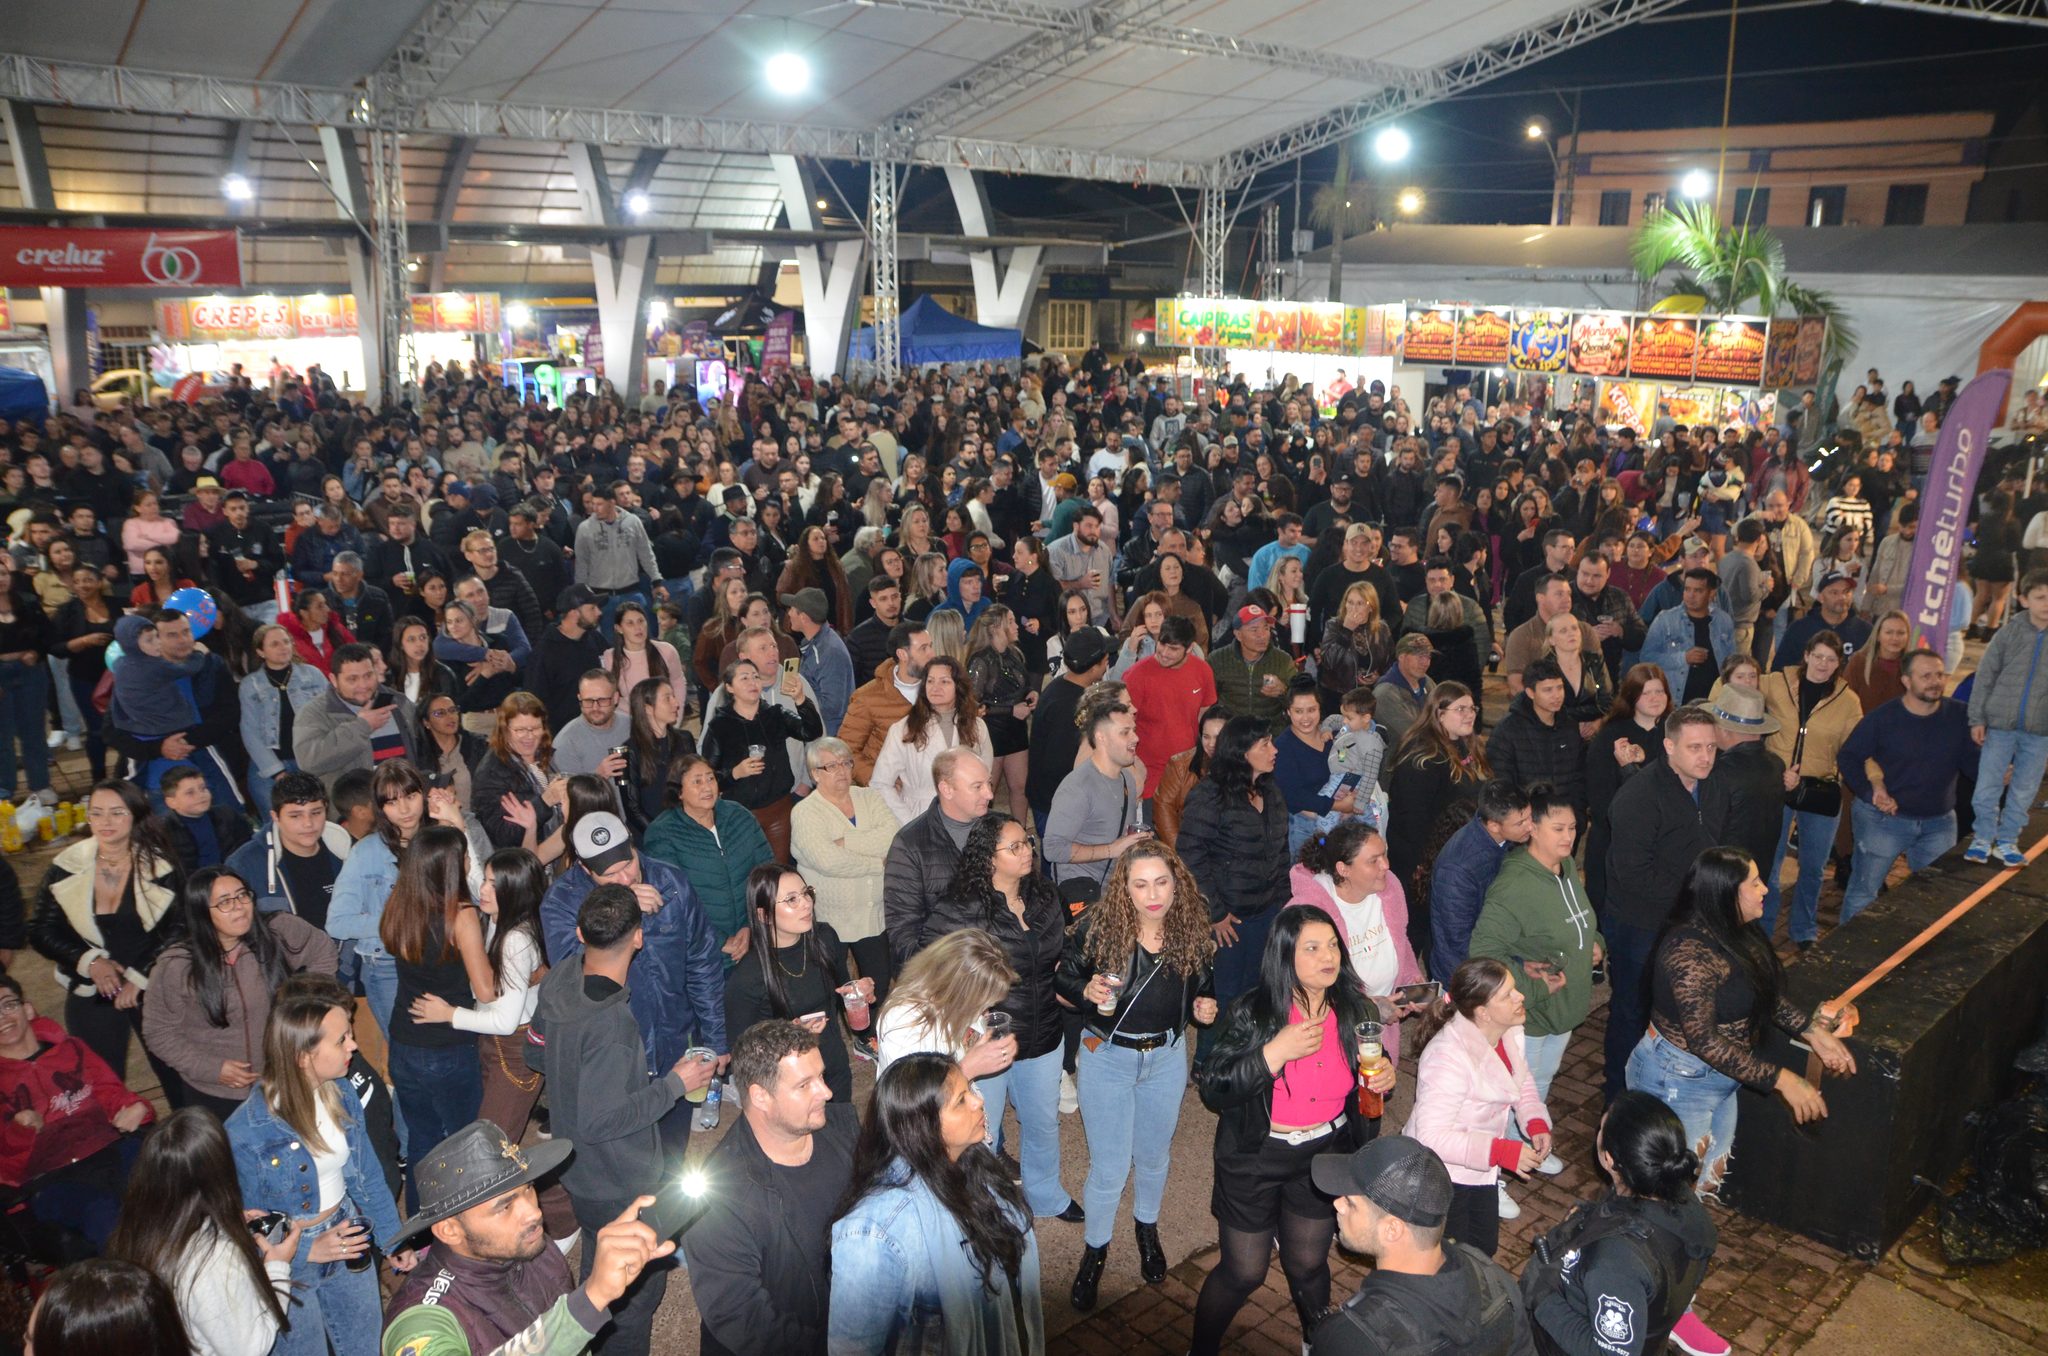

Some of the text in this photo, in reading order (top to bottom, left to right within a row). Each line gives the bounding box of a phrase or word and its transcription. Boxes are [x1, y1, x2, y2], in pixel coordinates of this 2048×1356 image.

[16, 242, 105, 266] creluz
[193, 303, 288, 326] CREPES
[1179, 310, 1251, 329] CAIPIRAS
[1257, 310, 1341, 337] DRINKS
[1578, 325, 1621, 340] Morango
[1609, 386, 1645, 435] KREPS
[1918, 427, 1972, 626] tchêturbo
